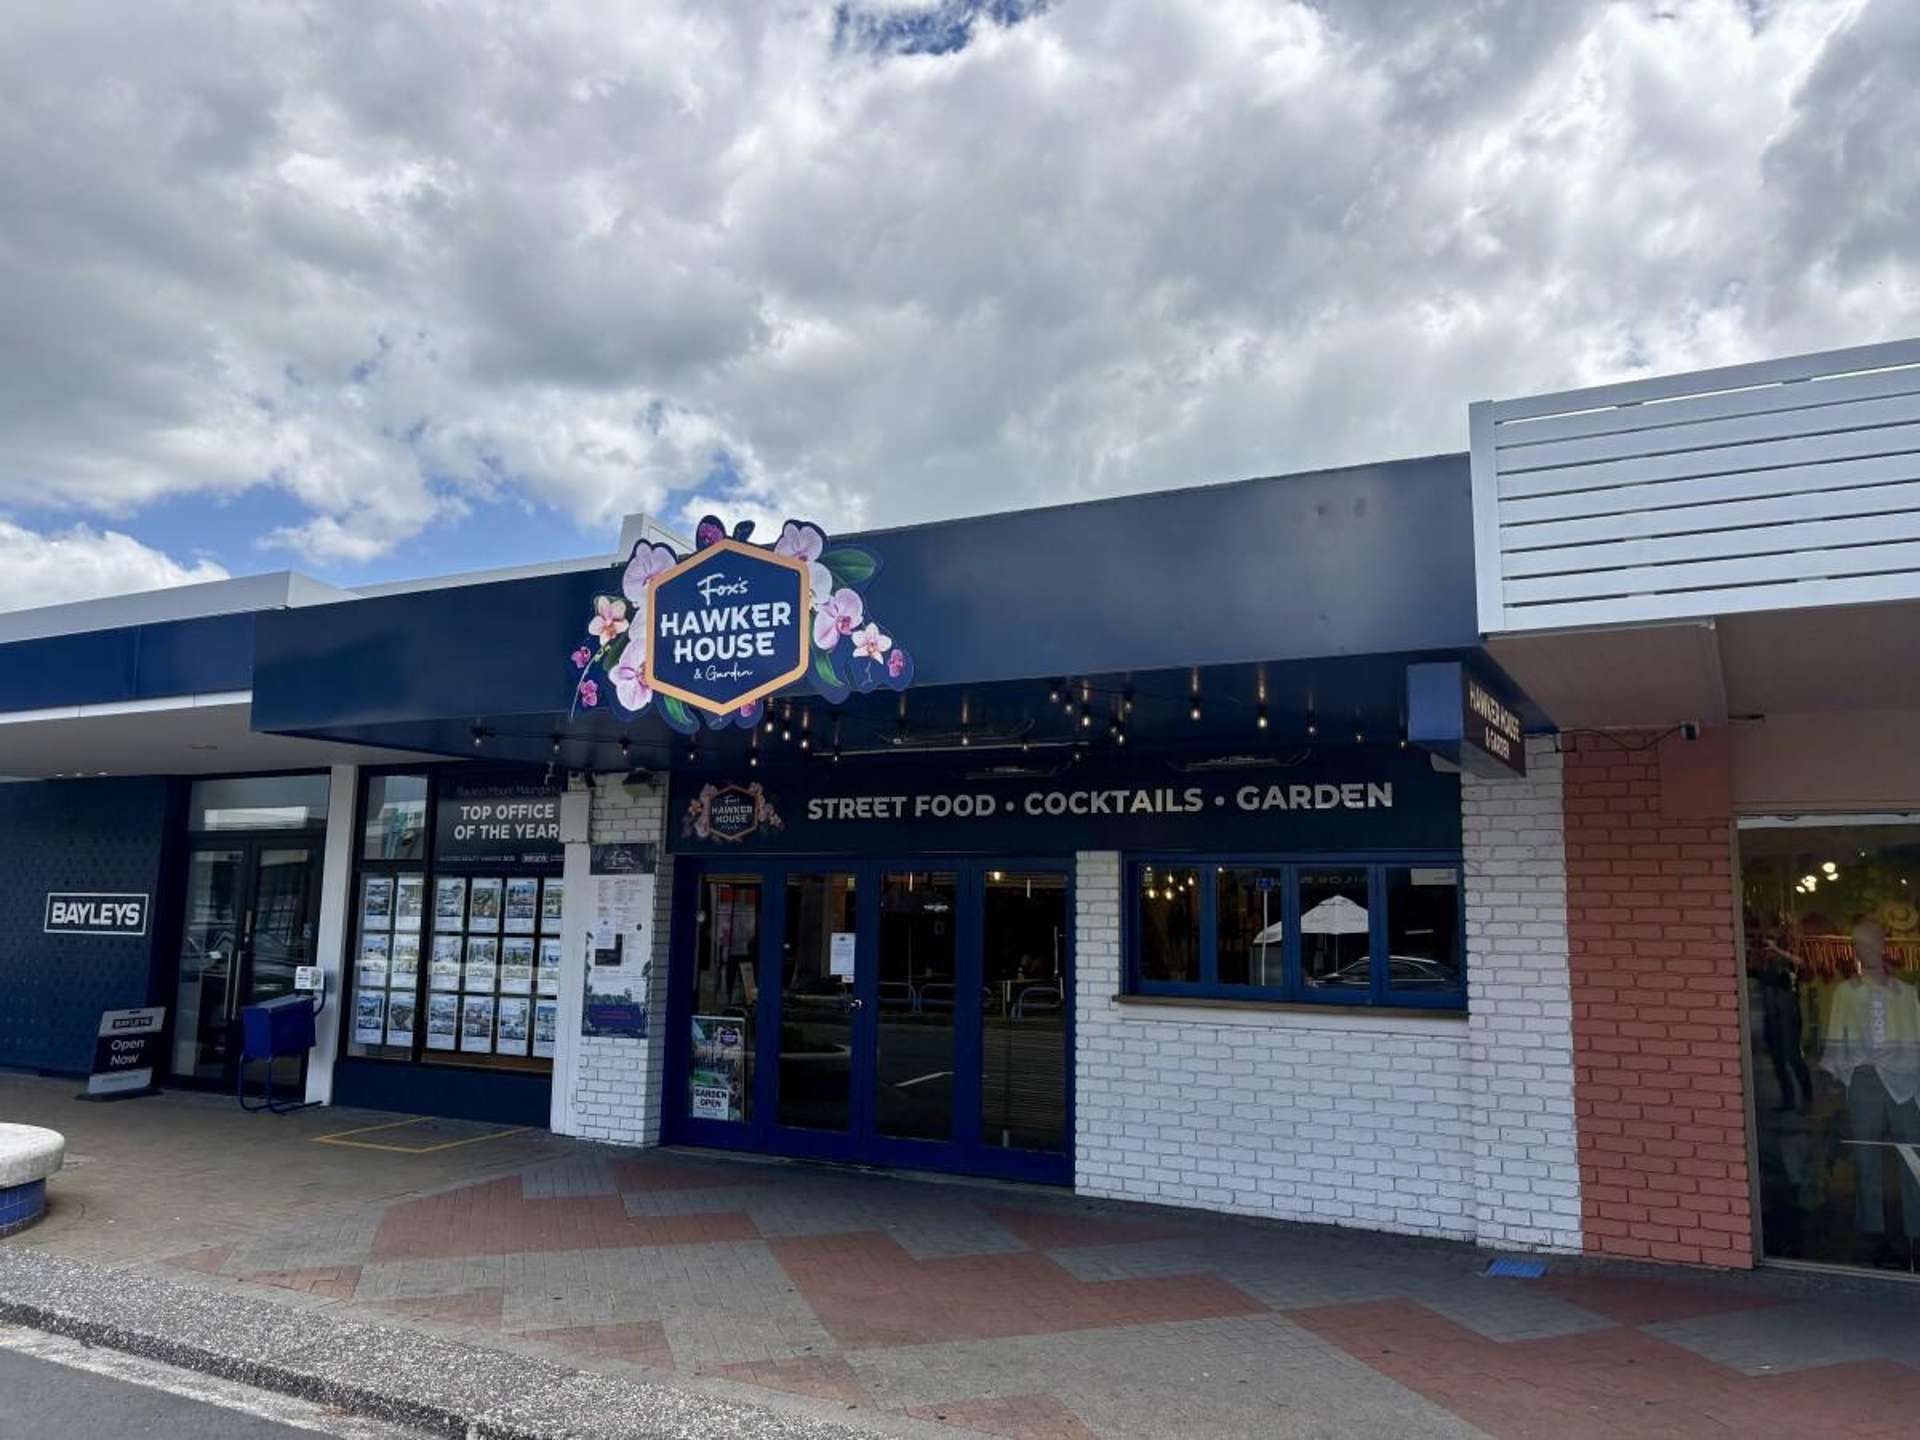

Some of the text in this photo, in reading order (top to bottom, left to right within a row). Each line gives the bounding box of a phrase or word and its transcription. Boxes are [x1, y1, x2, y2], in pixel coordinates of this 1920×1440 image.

[697, 573, 749, 606] Fox's
[660, 601, 792, 637] HAWKER
[674, 631, 776, 664] HOUSE
[694, 662, 753, 682] & Garden
[808, 782, 1393, 819] STREET FOOD COCKTAILS GARDEN
[460, 803, 555, 820] TOP OFFICE
[453, 823, 560, 840] OF THE YEAR
[51, 902, 140, 925] BAYLEYS
[111, 1039, 145, 1053] Open
[110, 1054, 140, 1067] Now
